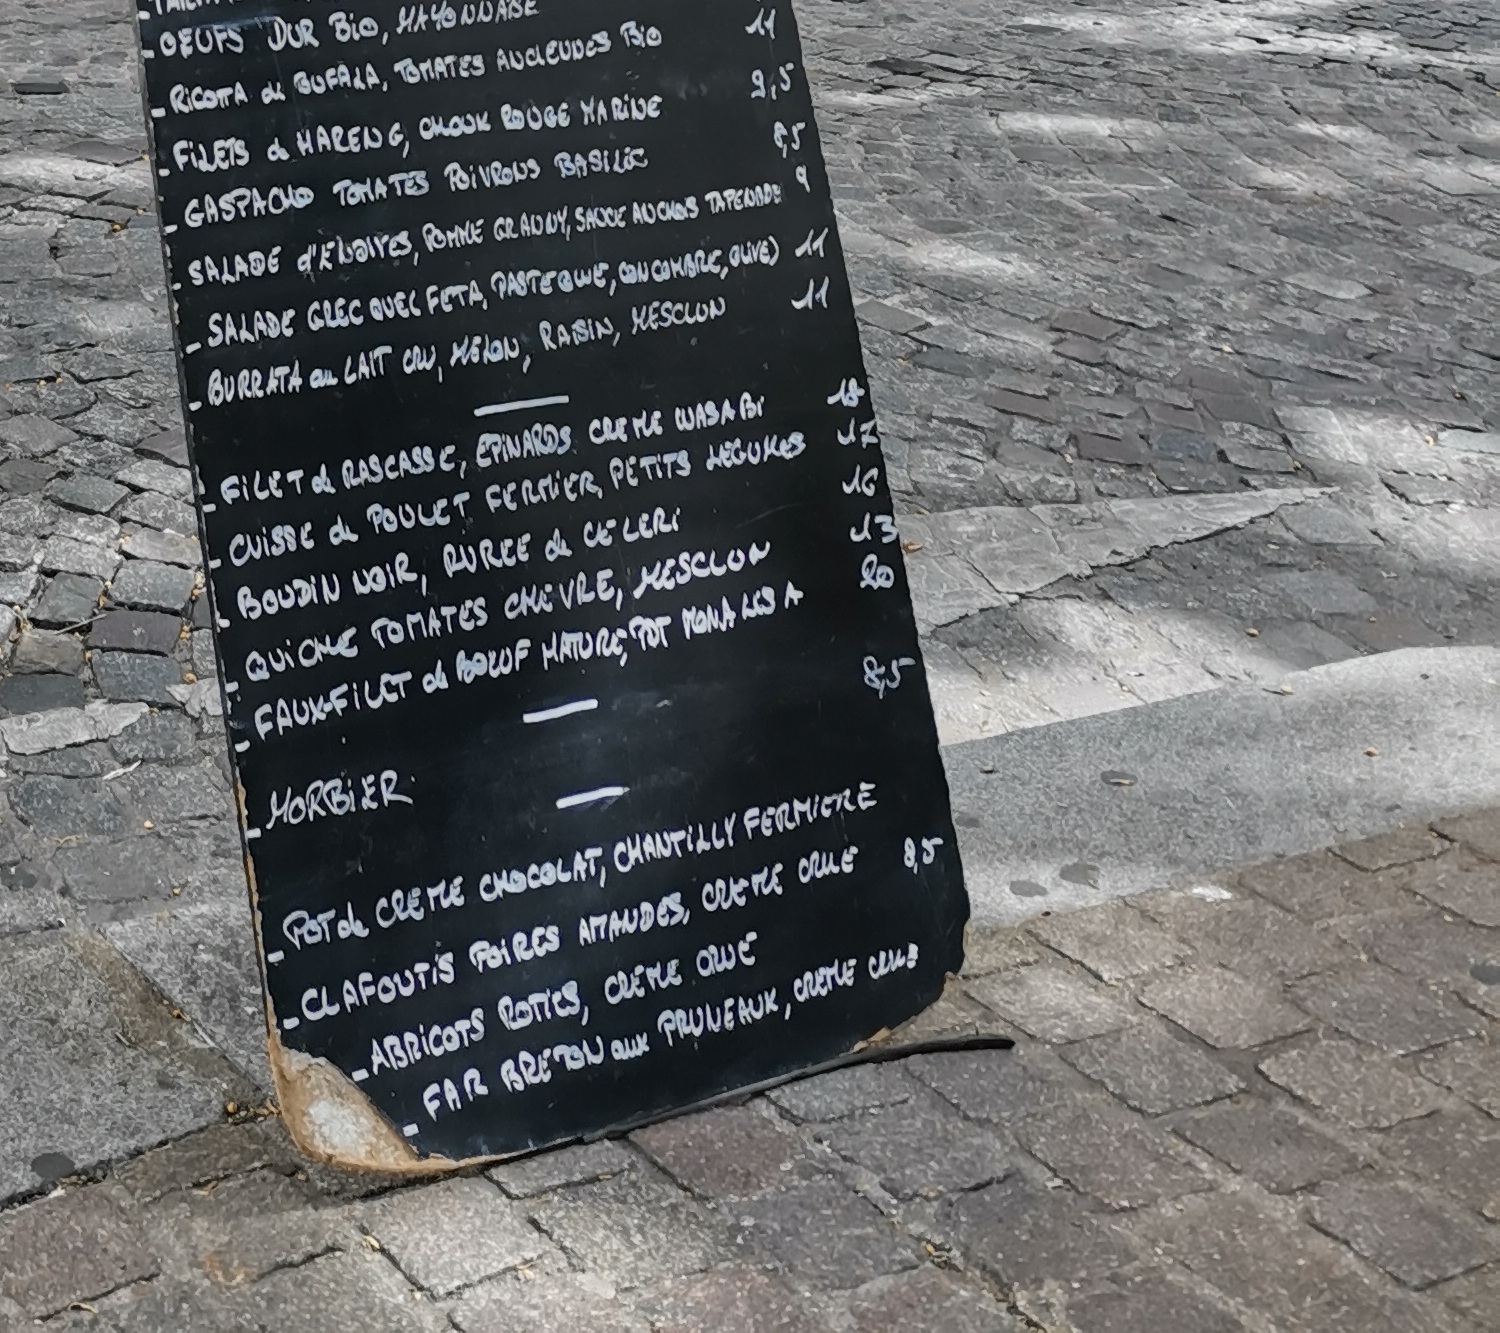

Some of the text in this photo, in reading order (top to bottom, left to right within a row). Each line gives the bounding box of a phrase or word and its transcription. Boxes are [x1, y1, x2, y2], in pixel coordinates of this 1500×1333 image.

[159, 25, 243, 58] OEUFS
[268, 16, 319, 51] DUR
[394, 54, 485, 83] TOMATES
[745, 7, 777, 40] 11
[750, 62, 795, 100] 9,5
[184, 183, 315, 229] GASPACHO
[333, 170, 430, 206] TOMATES
[188, 245, 282, 287] SALADE
[208, 308, 295, 348] SALADE
[795, 227, 829, 259] 11
[207, 359, 302, 407] BURRATA
[344, 345, 393, 385] LAIT
[631, 296, 726, 335] MESCLUN
[791, 275, 830, 311] 11
[841, 464, 879, 498] 16
[366, 491, 471, 534] POULET
[370, 596, 488, 649] TOMATES
[849, 514, 898, 544] 13
[859, 552, 895, 591] 20
[862, 655, 916, 700] 8,5
[479, 847, 606, 902] CHOCOLAT,
[903, 837, 943, 874] 8,5
[422, 1068, 488, 1122] FAR
